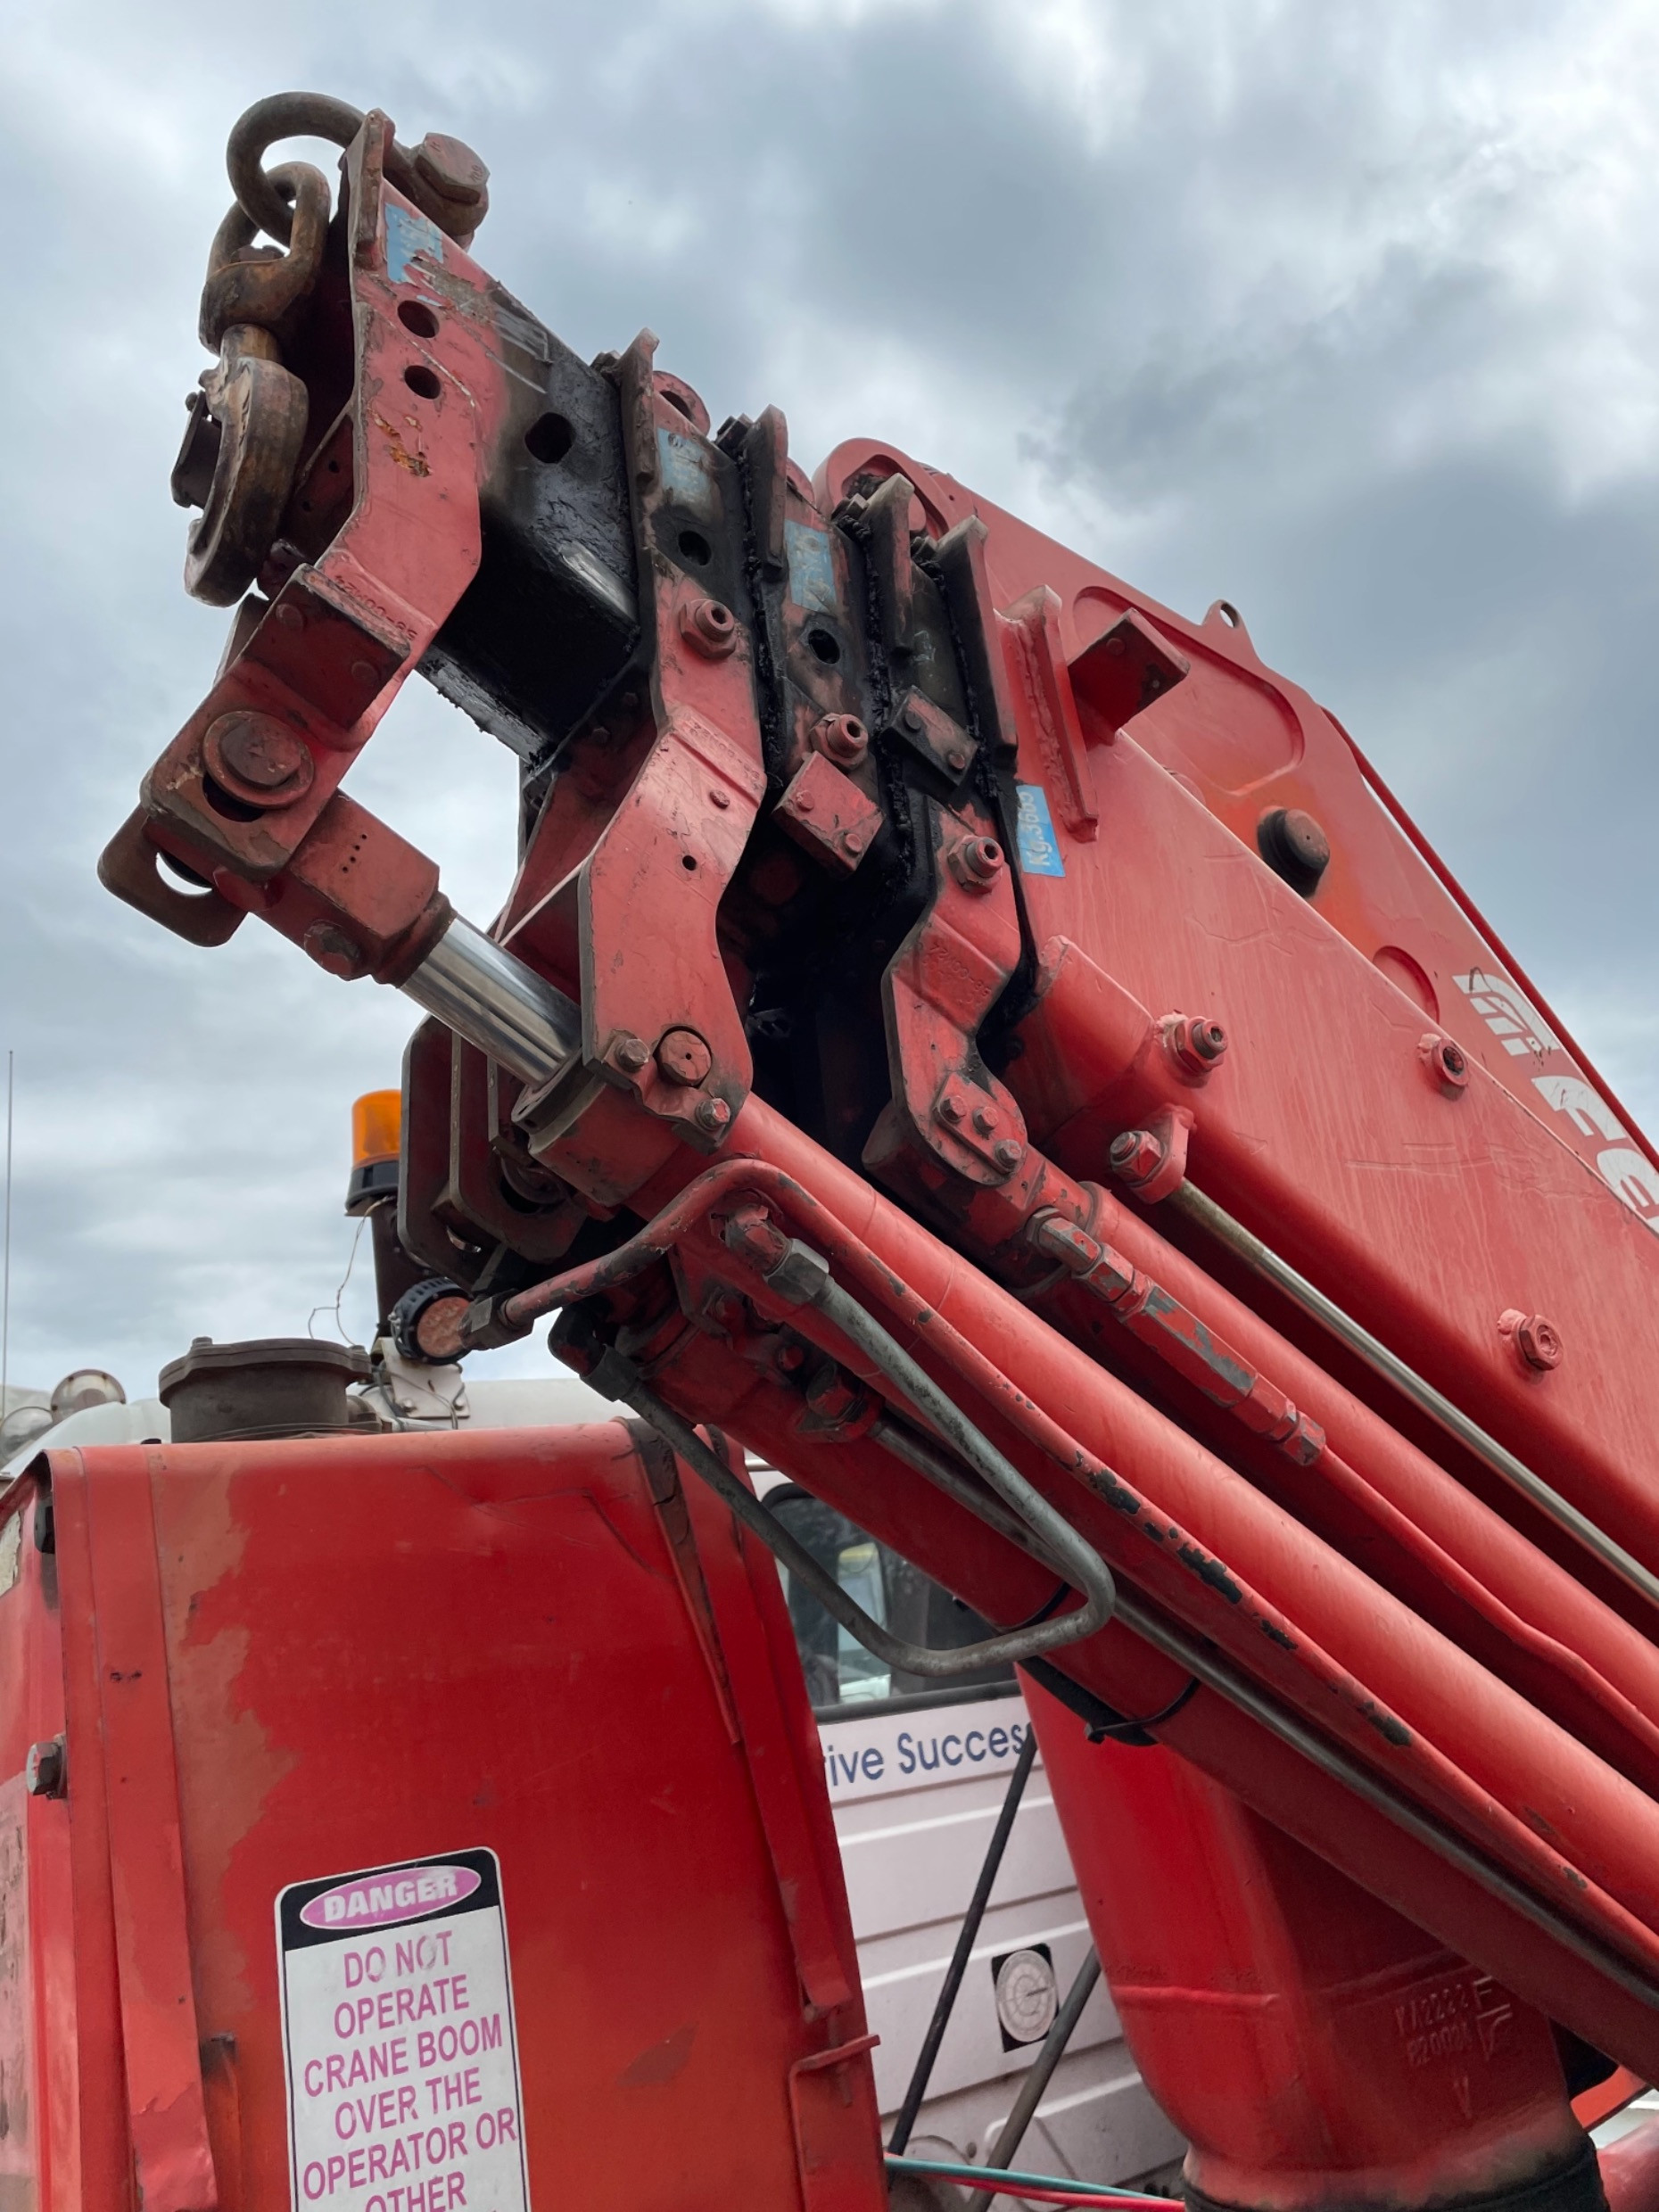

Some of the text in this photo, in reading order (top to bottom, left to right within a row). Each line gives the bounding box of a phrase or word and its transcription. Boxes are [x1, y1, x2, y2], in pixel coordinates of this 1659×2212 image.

[825, 1745, 885, 1787] ive
[323, 1874, 458, 1923] DANGER
[343, 1931, 453, 1989] DO NOT
[334, 1974, 470, 2039] OPERATE
[304, 2013, 503, 2097] CRANE BOOM
[334, 2067, 483, 2140] OVER THE
[303, 2107, 517, 2200] OPERATOR OR
